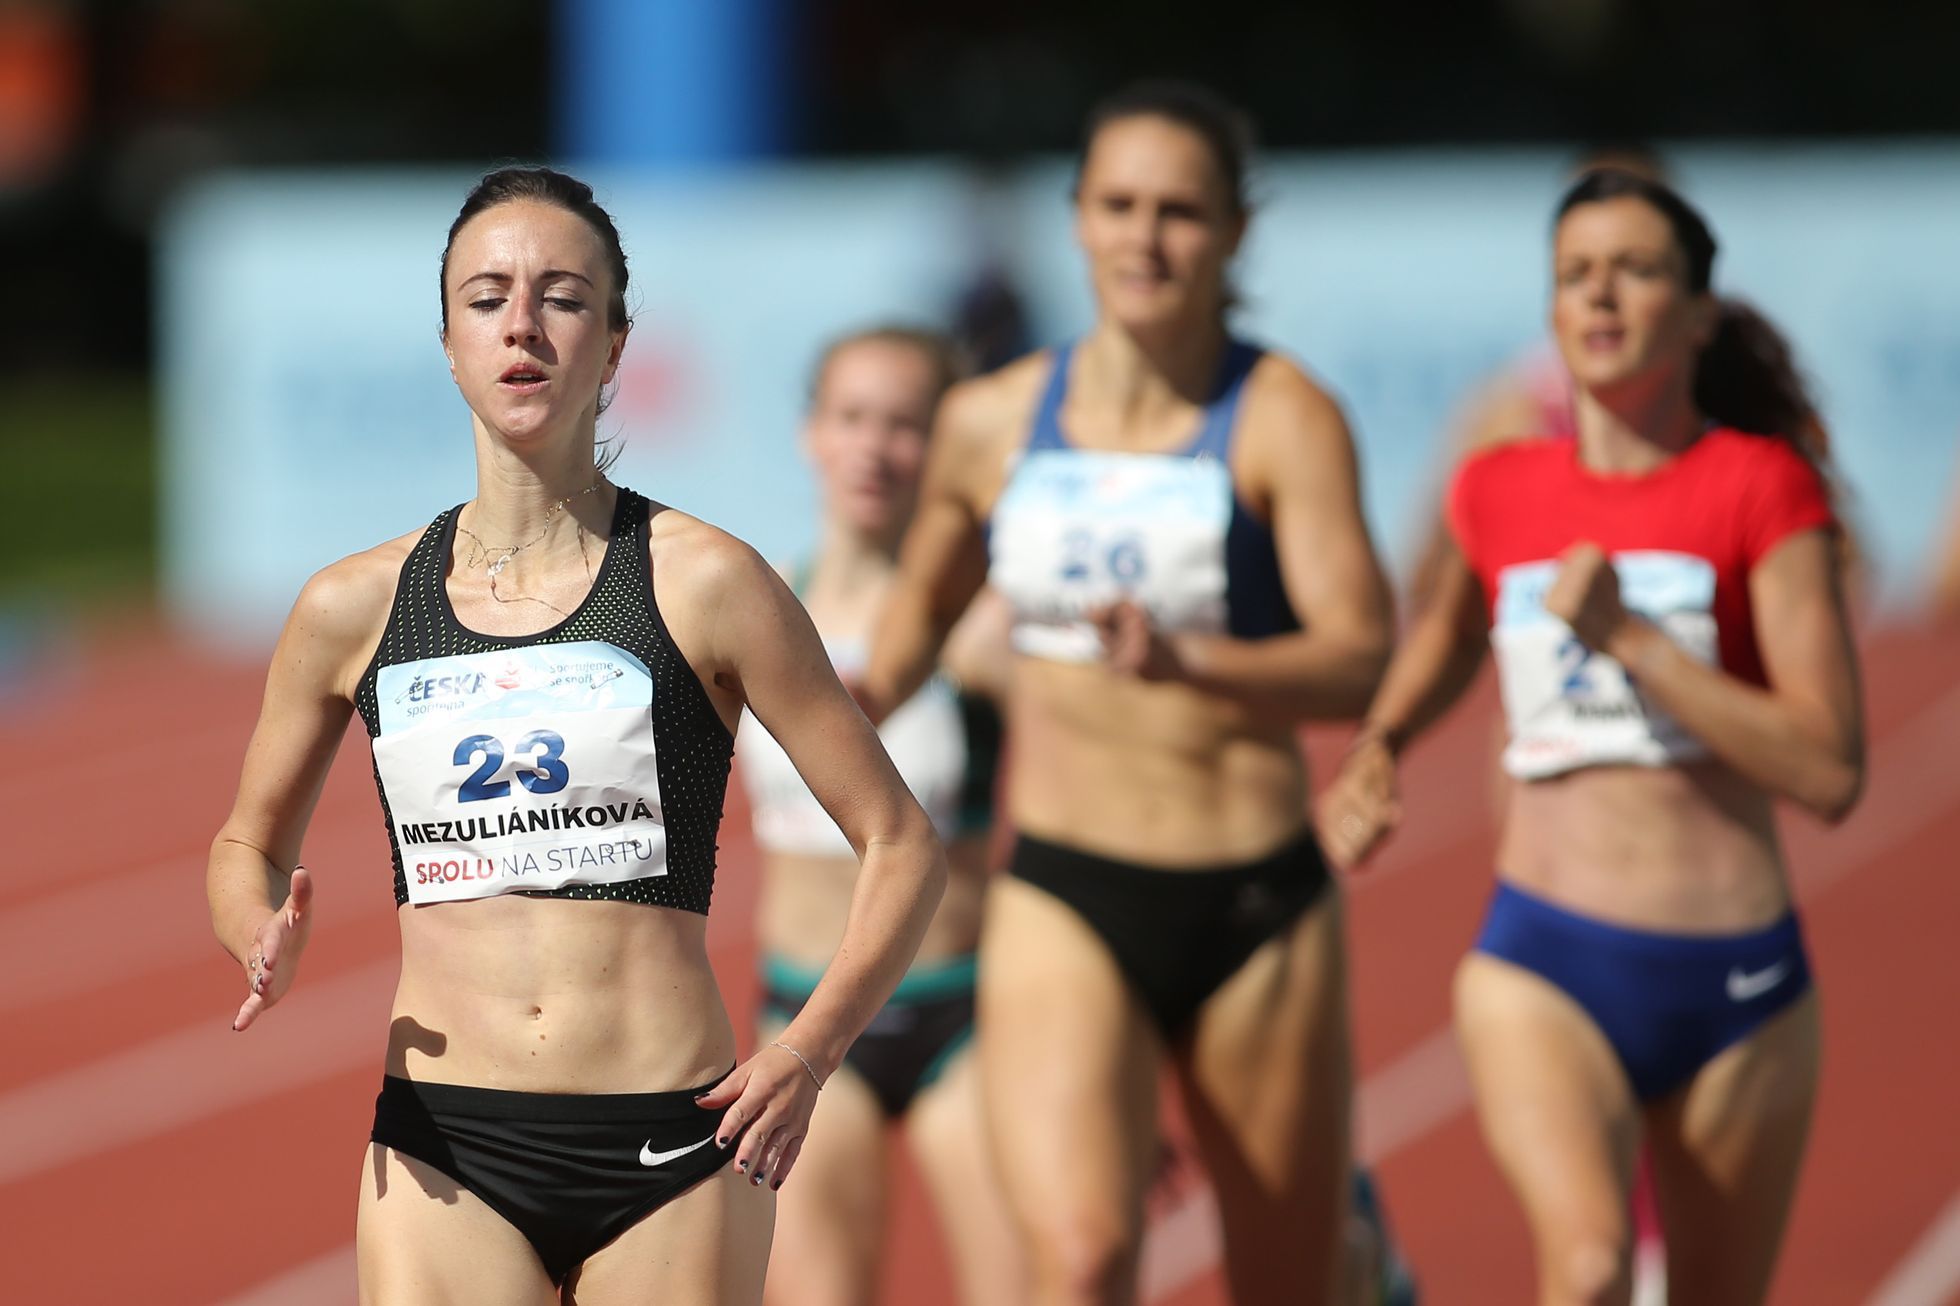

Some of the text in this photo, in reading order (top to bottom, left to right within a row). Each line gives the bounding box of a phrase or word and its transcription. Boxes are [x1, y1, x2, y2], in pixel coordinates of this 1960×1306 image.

[1059, 527, 1148, 584] 26
[452, 729, 570, 804] 23
[401, 798, 654, 845] MEZULIÁNÍKOVÁ
[416, 838, 654, 885] SPOLU NA STARTU
